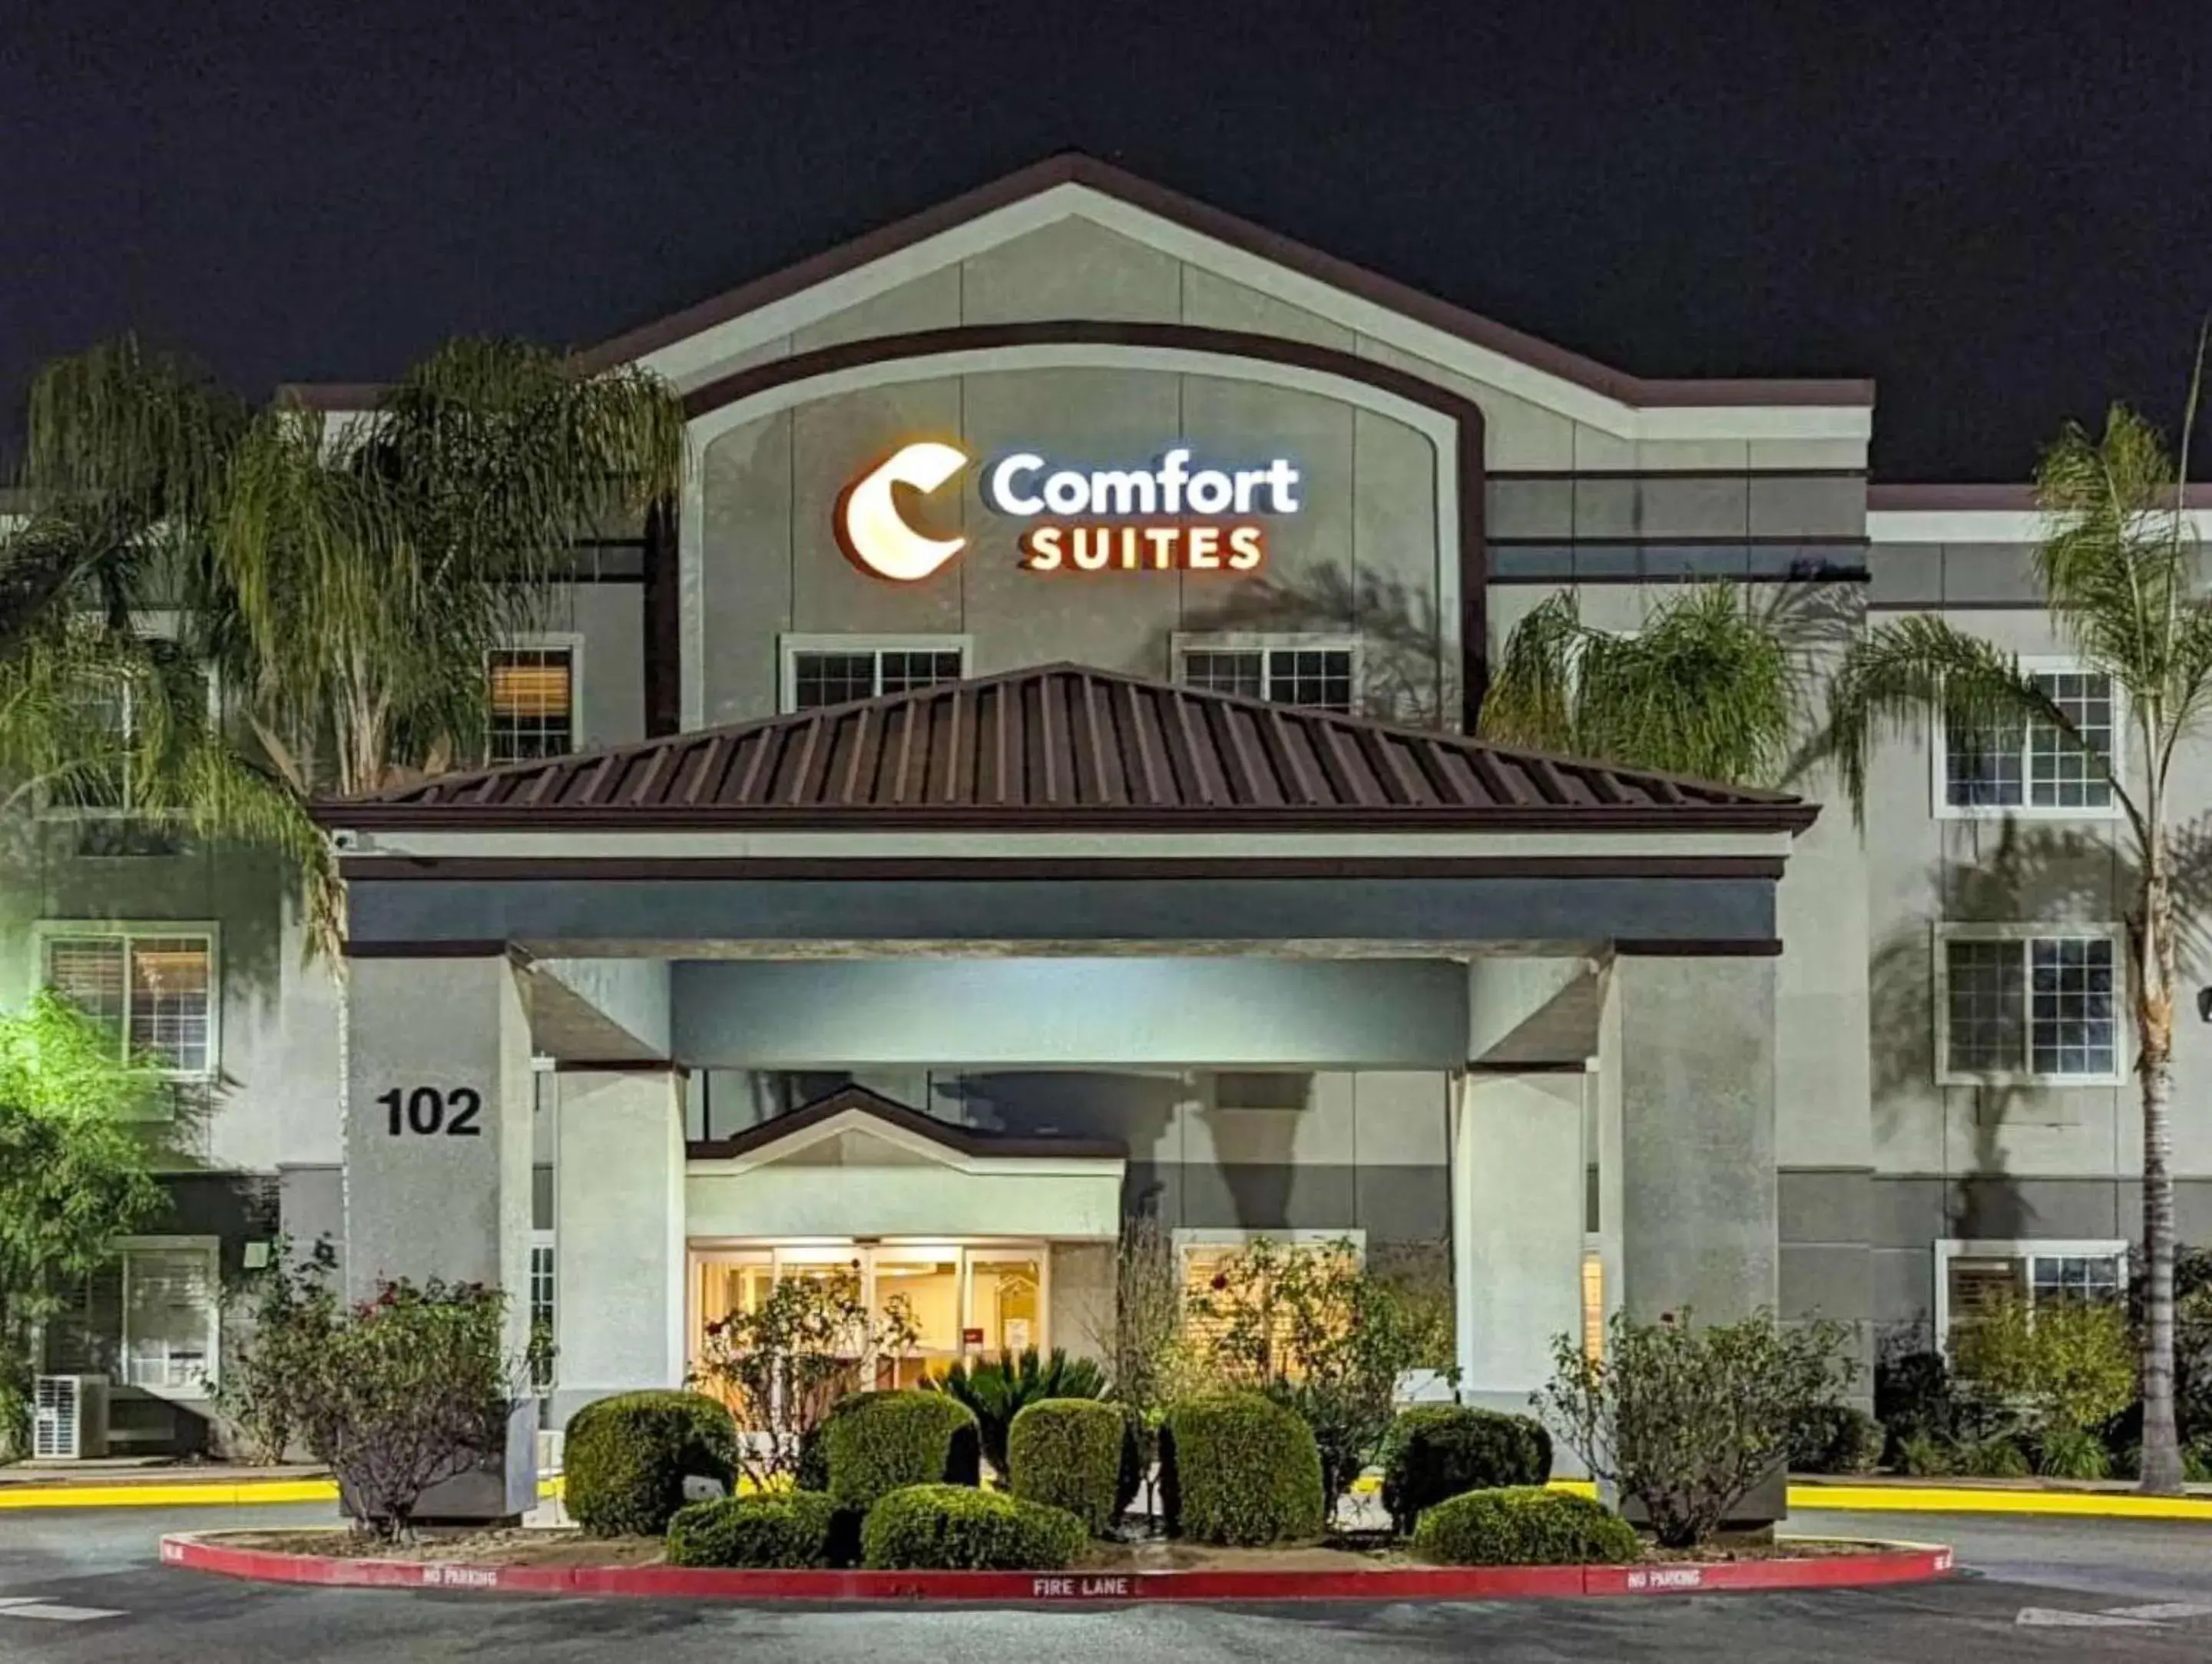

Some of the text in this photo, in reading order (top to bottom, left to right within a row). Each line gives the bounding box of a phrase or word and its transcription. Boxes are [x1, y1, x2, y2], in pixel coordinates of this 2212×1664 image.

[992, 449, 1300, 515] Comfort
[1028, 525, 1262, 570] SUITES
[376, 1086, 482, 1136] 102
[424, 1568, 497, 1587] NO PARKING
[1033, 1578, 1074, 1596] FIRE
[1082, 1577, 1128, 1596] LANE
[1628, 1569, 1700, 1589] NO PARKING
